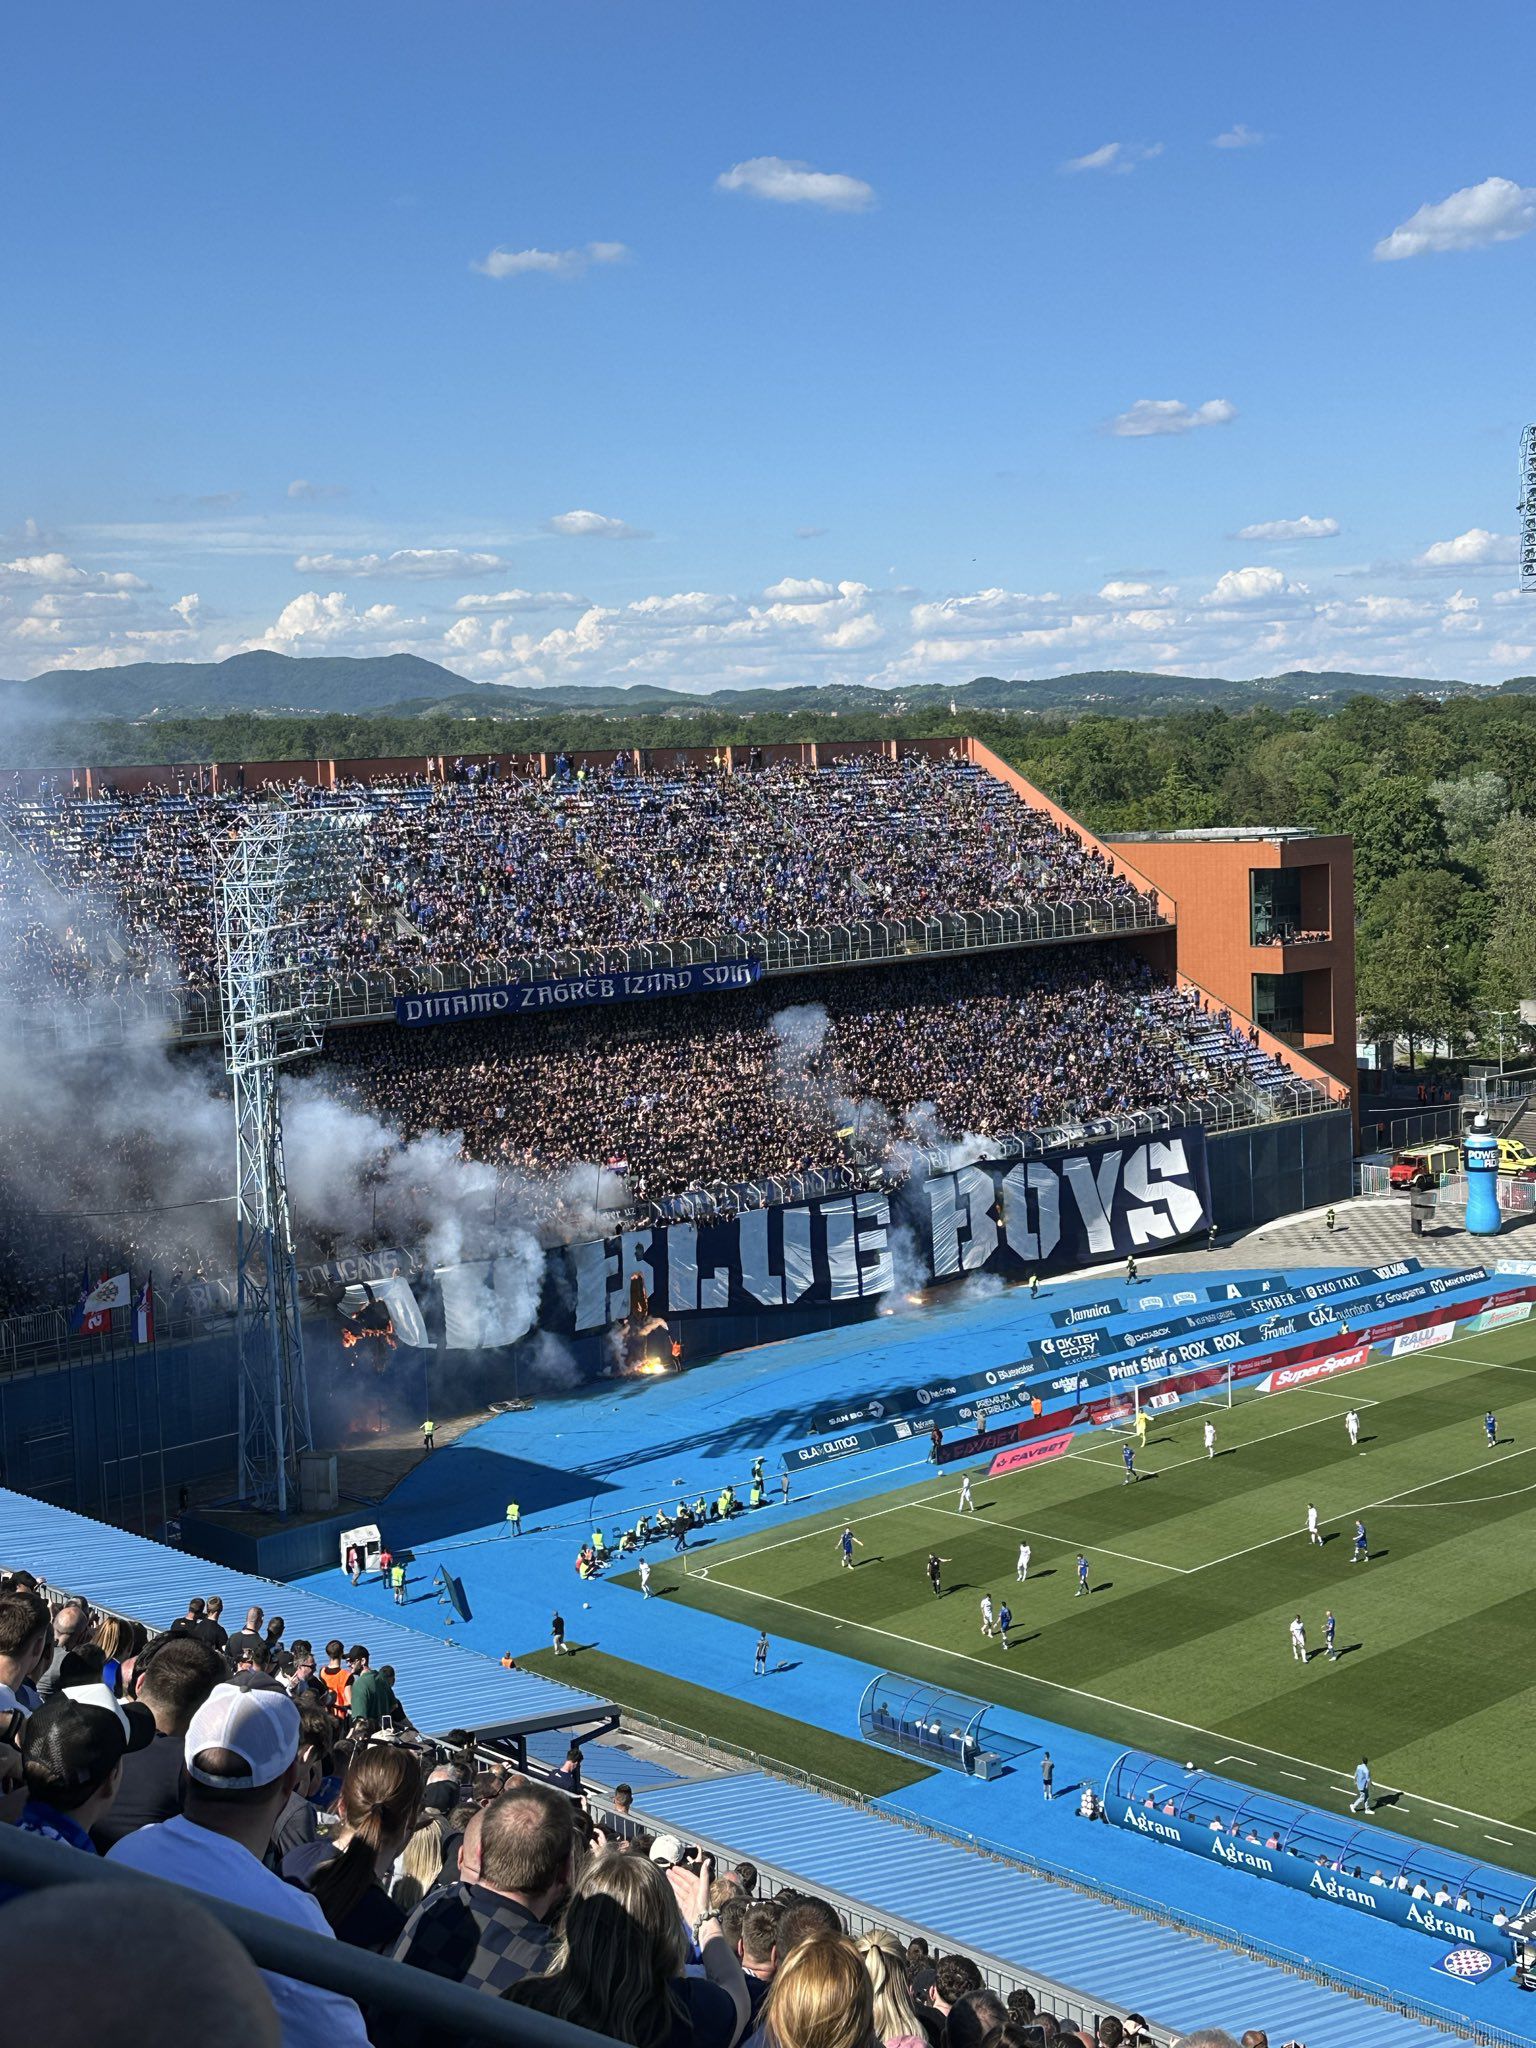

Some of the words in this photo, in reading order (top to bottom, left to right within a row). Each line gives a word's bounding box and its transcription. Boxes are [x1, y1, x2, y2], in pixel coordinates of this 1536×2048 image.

[406, 990, 508, 1021] DINAMO
[520, 979, 614, 1006] ZAGREB
[623, 970, 692, 995] IZNAD
[574, 1192, 895, 1331] BLUE
[923, 1138, 1203, 1277] BOYS
[1317, 1282, 1337, 1296] EKO
[1336, 1275, 1361, 1291] TAXI
[1385, 1286, 1426, 1303] Groupama
[1065, 1303, 1111, 1326] Jamnica
[1259, 1317, 1297, 1341] Franck
[1134, 1326, 1171, 1342] DATABOX
[1060, 1342, 1096, 1359] COPY
[1108, 1360, 1140, 1381] Print
[1178, 1341, 1210, 1362] ROX
[1213, 1331, 1246, 1351] ROX
[997, 1363, 1034, 1381] Bluewater
[1275, 1350, 1364, 1386] SuperSport
[976, 1393, 1011, 1408] PREMIUM
[1009, 1439, 1069, 1468] FAVBET
[1123, 1806, 1182, 1842] Agram
[1211, 1836, 1273, 1873] Agram
[1309, 1869, 1377, 1909] Agram
[1406, 1902, 1477, 1943] Agram
